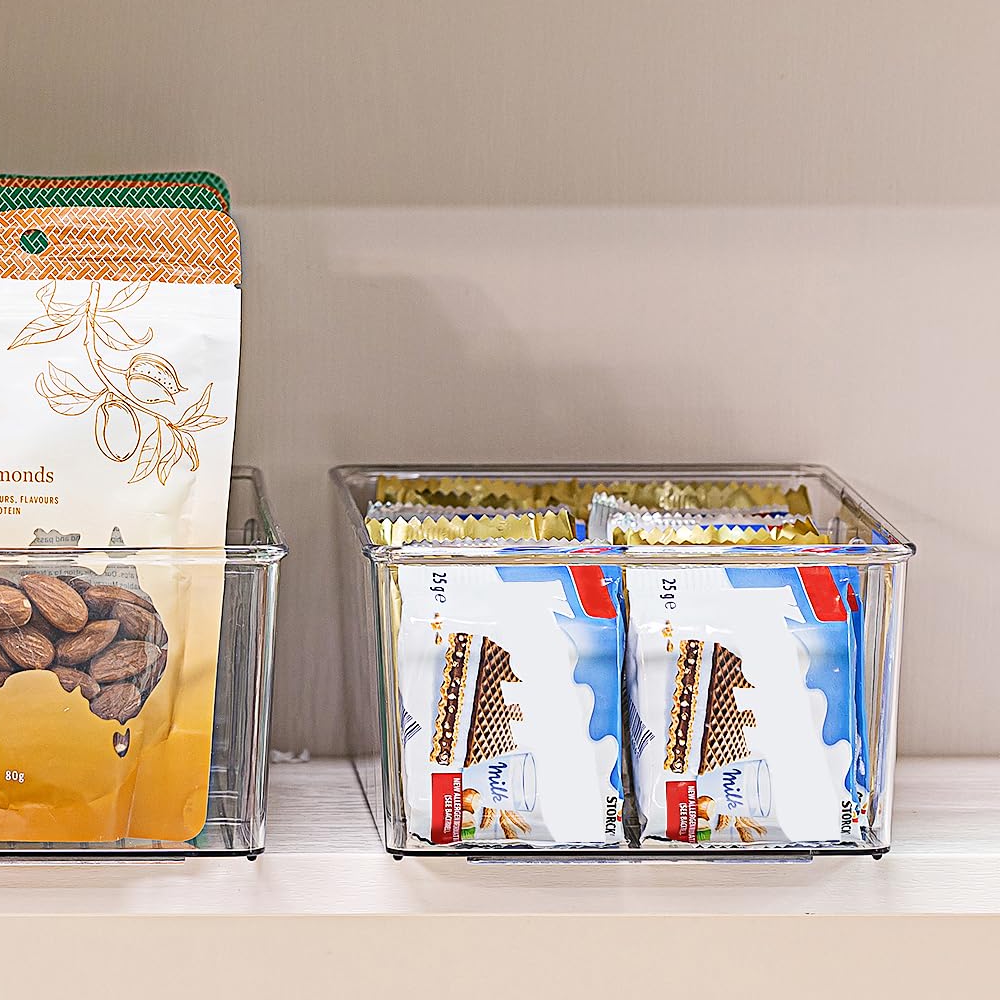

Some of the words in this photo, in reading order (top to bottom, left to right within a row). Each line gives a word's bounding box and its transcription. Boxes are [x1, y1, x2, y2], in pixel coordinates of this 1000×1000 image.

[20, 496, 59, 504] FLAVOURS
[5, 770, 25, 783] 80g
[453, 777, 461, 792] NEW
[688, 785, 696, 800] NEW
[444, 794, 452, 808] (SEE
[605, 796, 618, 834] STORCK
[680, 802, 688, 816] (SEE
[841, 801, 852, 835] STORCK
